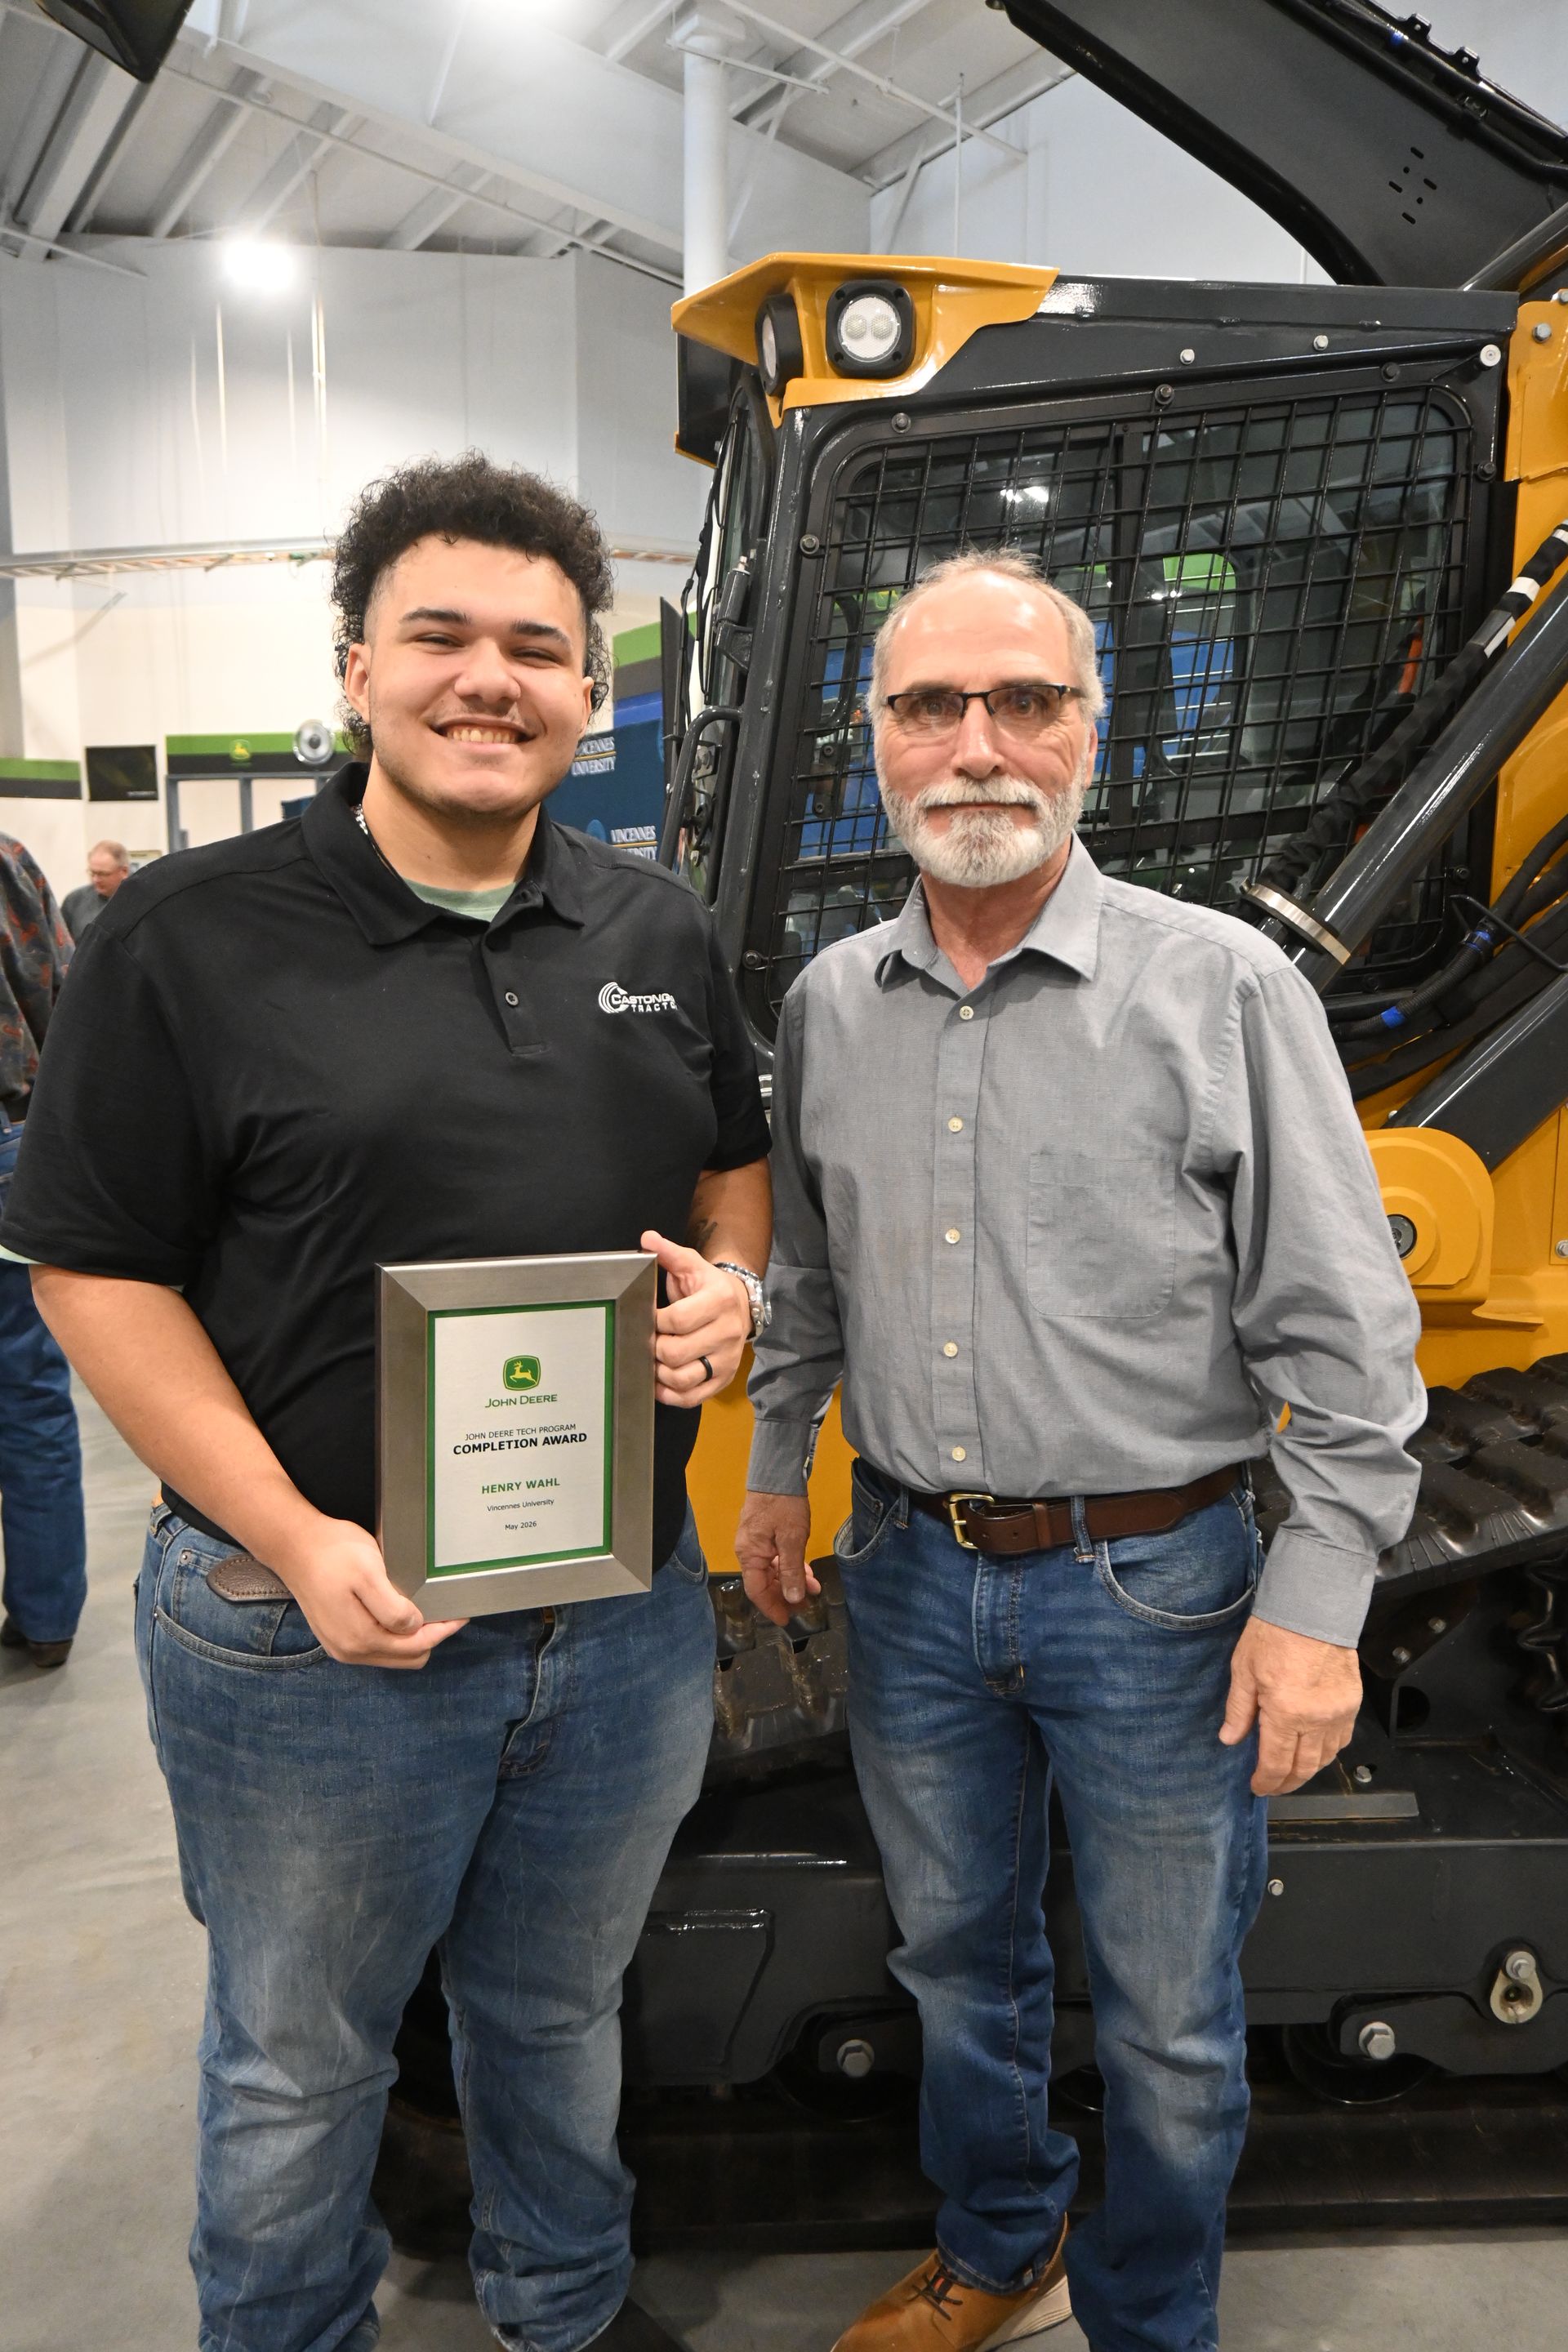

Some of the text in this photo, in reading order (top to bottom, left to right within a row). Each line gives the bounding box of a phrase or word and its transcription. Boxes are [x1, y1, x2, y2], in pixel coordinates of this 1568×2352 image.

[485, 1394, 558, 1408] JOHN DEERE
[465, 1423, 577, 1441] JOHN DEERE TECH PROGRAM
[453, 1432, 587, 1454] COMPLETION AWARD
[482, 1477, 561, 1494] HENRY WAHL
[487, 1499, 555, 1512] Vincennes University
[520, 1521, 537, 1529] 2026
